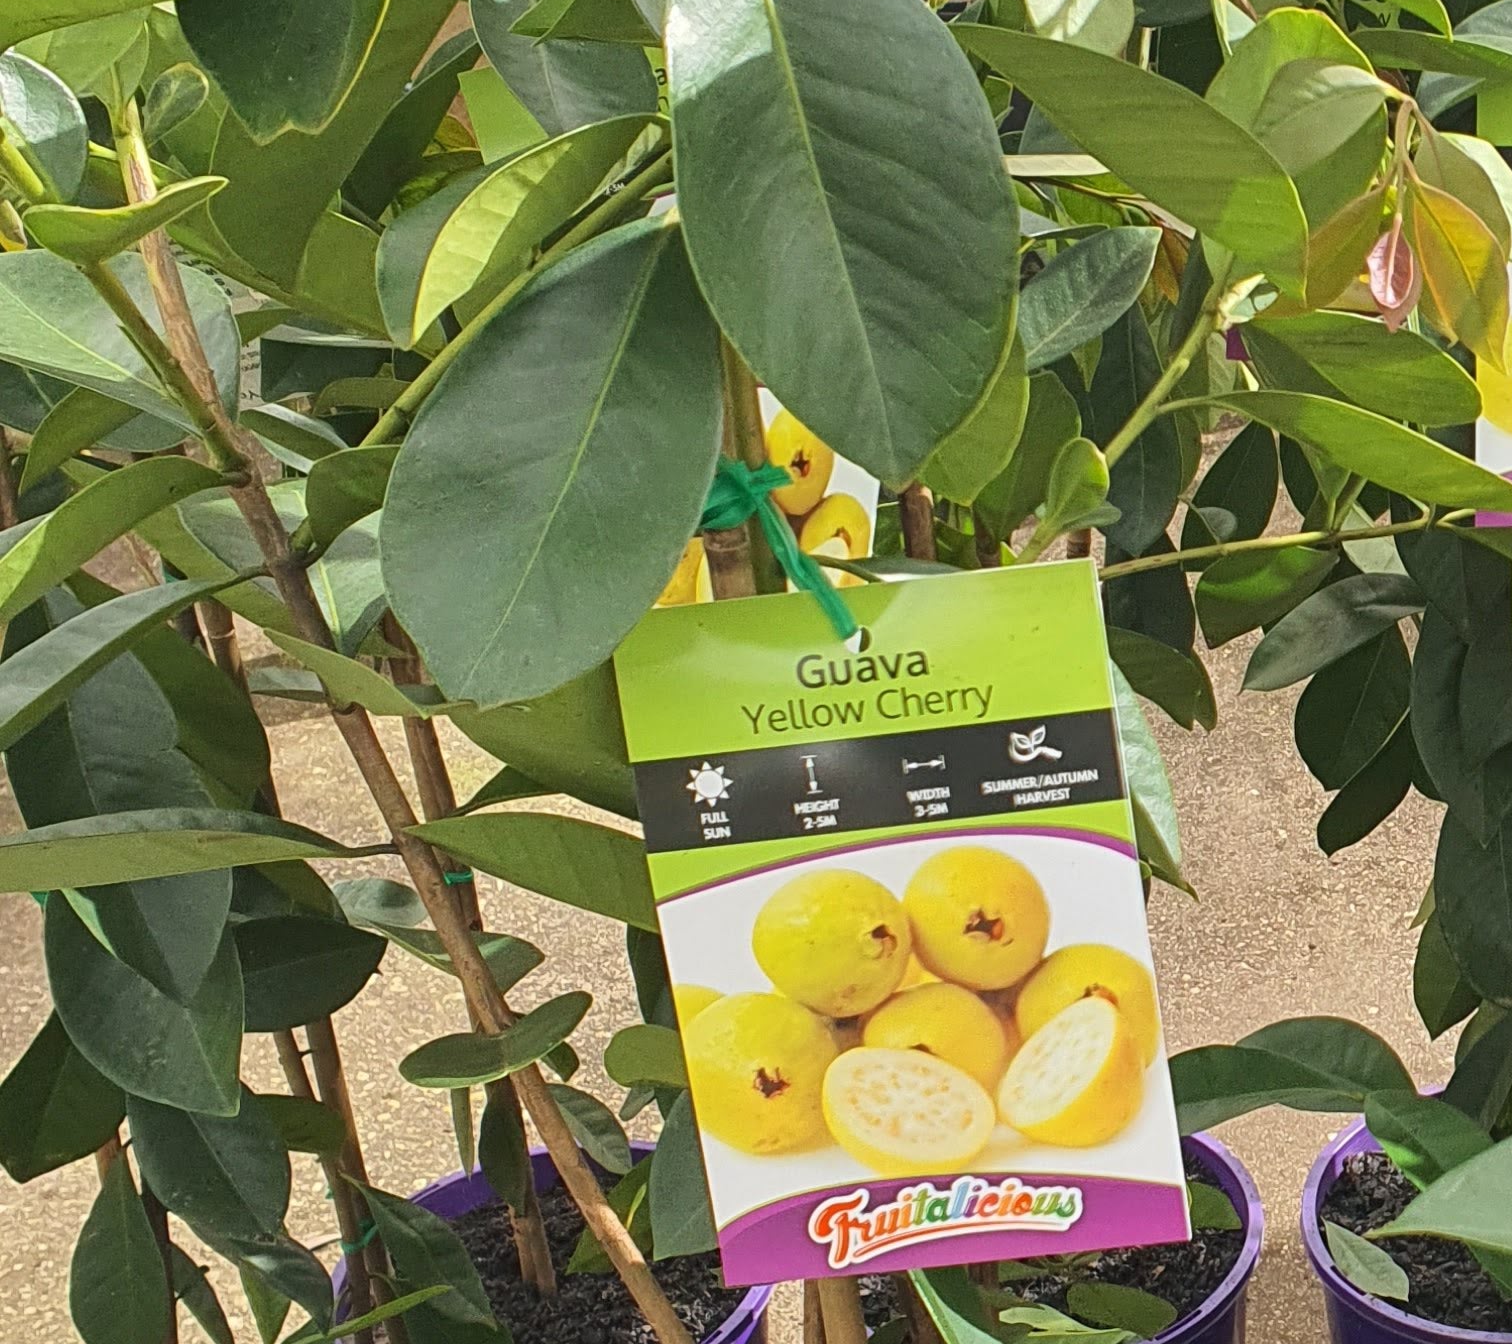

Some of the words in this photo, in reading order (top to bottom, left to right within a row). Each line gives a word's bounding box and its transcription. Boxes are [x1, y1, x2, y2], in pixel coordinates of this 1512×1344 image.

[796, 650, 930, 689] Guava
[741, 699, 865, 735] Yellow
[876, 685, 993, 719] Cherry
[981, 769, 1099, 795] SUMMER/AUTUMN
[906, 786, 950, 803] WIDTH
[1013, 787, 1071, 807] HARVEST
[793, 798, 840, 815] HEIGHT
[914, 802, 949, 818] 3-5M
[700, 811, 730, 825] FULL
[803, 814, 838, 830] 2-5M
[703, 826, 732, 840] SUN
[812, 1178, 1078, 1265] Fruitalicious
